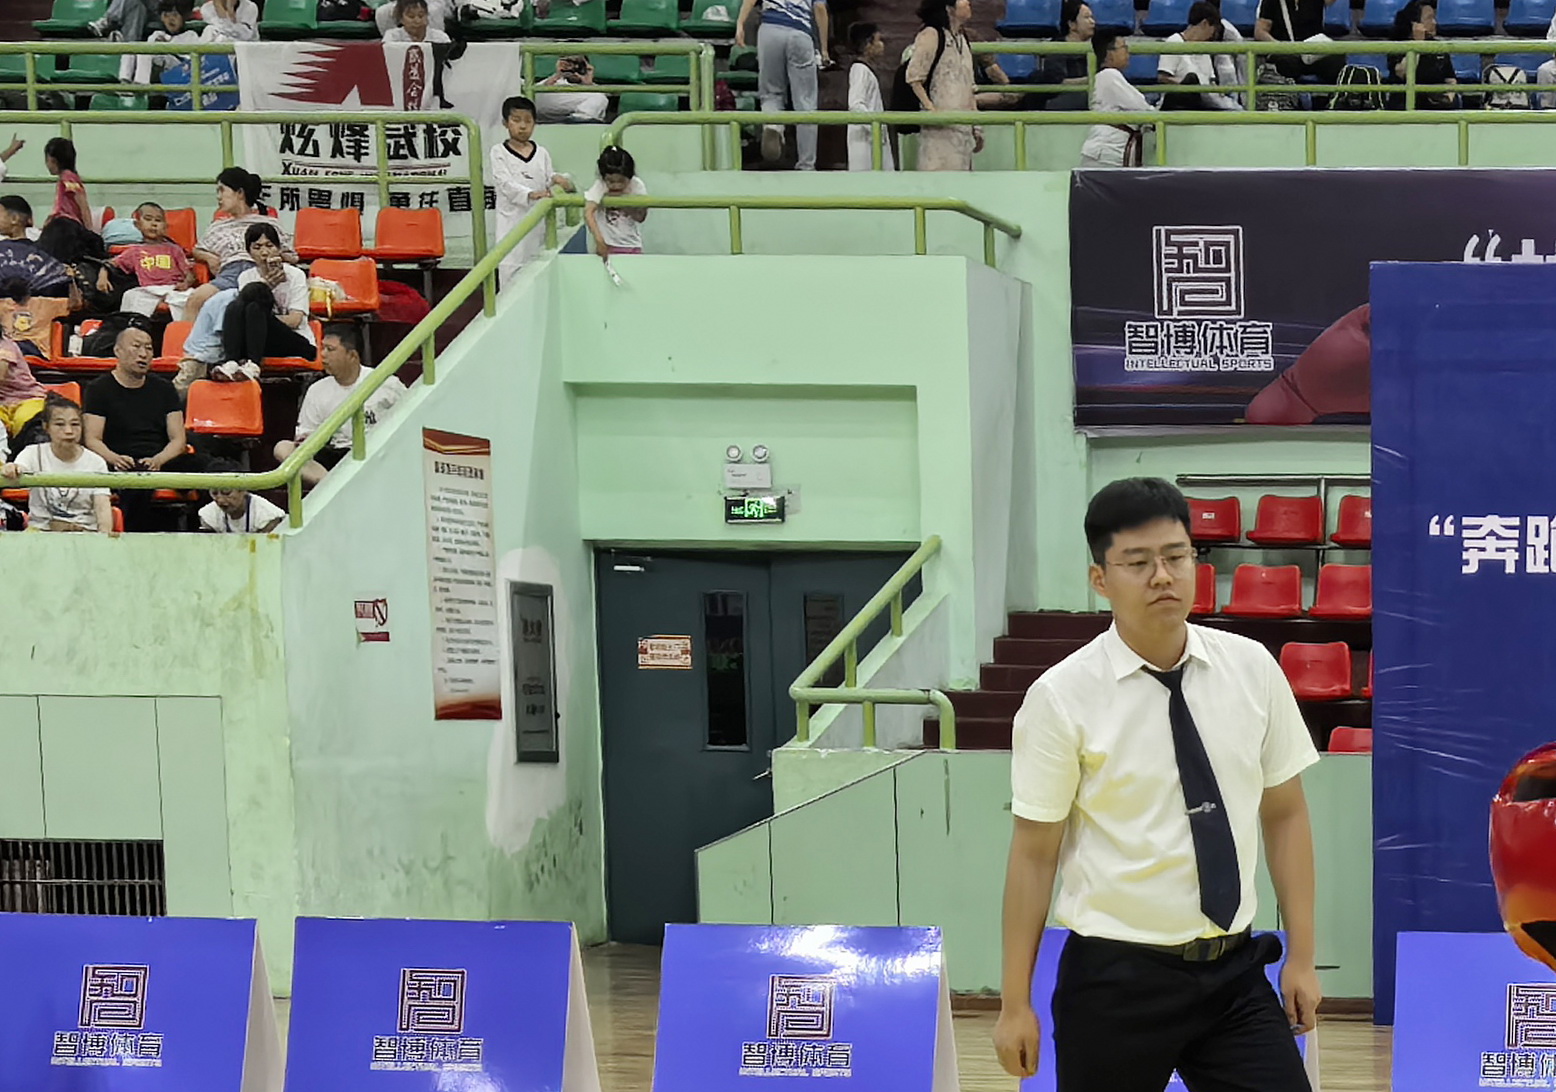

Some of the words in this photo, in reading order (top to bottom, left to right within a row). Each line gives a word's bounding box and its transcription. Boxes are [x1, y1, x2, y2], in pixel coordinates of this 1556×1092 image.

[1124, 321, 1273, 356] 智博体育
[1124, 356, 1218, 371] INTELLECTUAL
[1220, 356, 1275, 371] SPORTS
[53, 1031, 164, 1057] 智博体育
[372, 1035, 484, 1062] 智博体育
[742, 1041, 853, 1068] 智博体育
